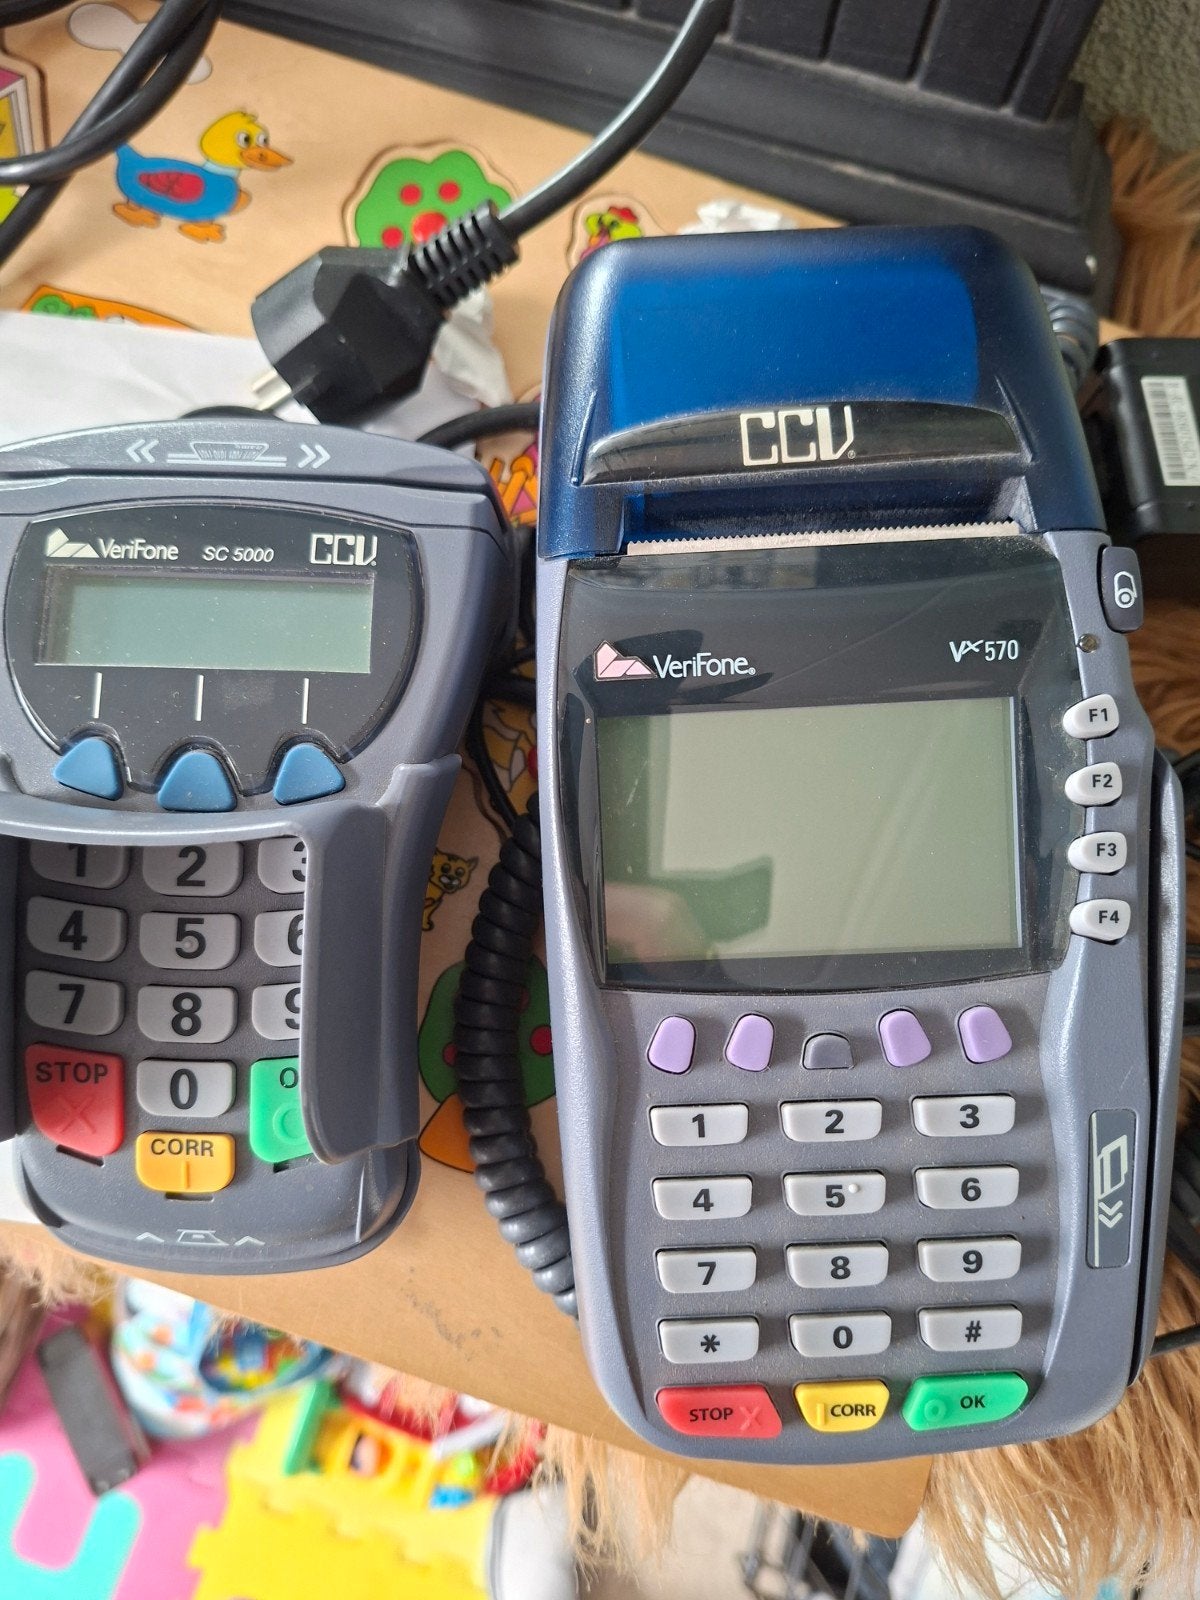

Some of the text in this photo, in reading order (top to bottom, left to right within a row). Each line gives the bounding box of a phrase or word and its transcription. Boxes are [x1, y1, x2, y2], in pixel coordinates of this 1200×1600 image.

[740, 405, 854, 466] CCV
[98, 538, 274, 562] VeriFone SC 5000
[310, 533, 377, 566] CCV
[652, 652, 749, 679] VeriFone
[1089, 708, 1107, 722] F1
[1093, 774, 1112, 787] F2
[67, 844, 87, 878] 1
[1097, 843, 1116, 856] F3
[175, 846, 207, 887] 2
[1099, 911, 1119, 923] F4
[59, 910, 87, 950] 4
[175, 917, 206, 959] 5
[59, 984, 84, 1024] 7
[171, 992, 201, 1036] 8
[35, 1062, 108, 1085] STOP
[170, 1068, 198, 1109] 0
[692, 1114, 705, 1138] 1
[825, 1110, 844, 1133] 2
[960, 1104, 979, 1128] 3
[150, 1138, 214, 1158] CORR
[693, 1189, 714, 1211] 4
[826, 1185, 845, 1208] 5
[961, 1178, 981, 1201] 6
[831, 1256, 850, 1279] 8
[963, 1250, 982, 1273] 9
[698, 1262, 716, 1285] 7
[833, 1326, 853, 1349] 0
[831, 1404, 876, 1417] CORR
[960, 1396, 985, 1409] OK
[690, 1408, 733, 1422] STOP
